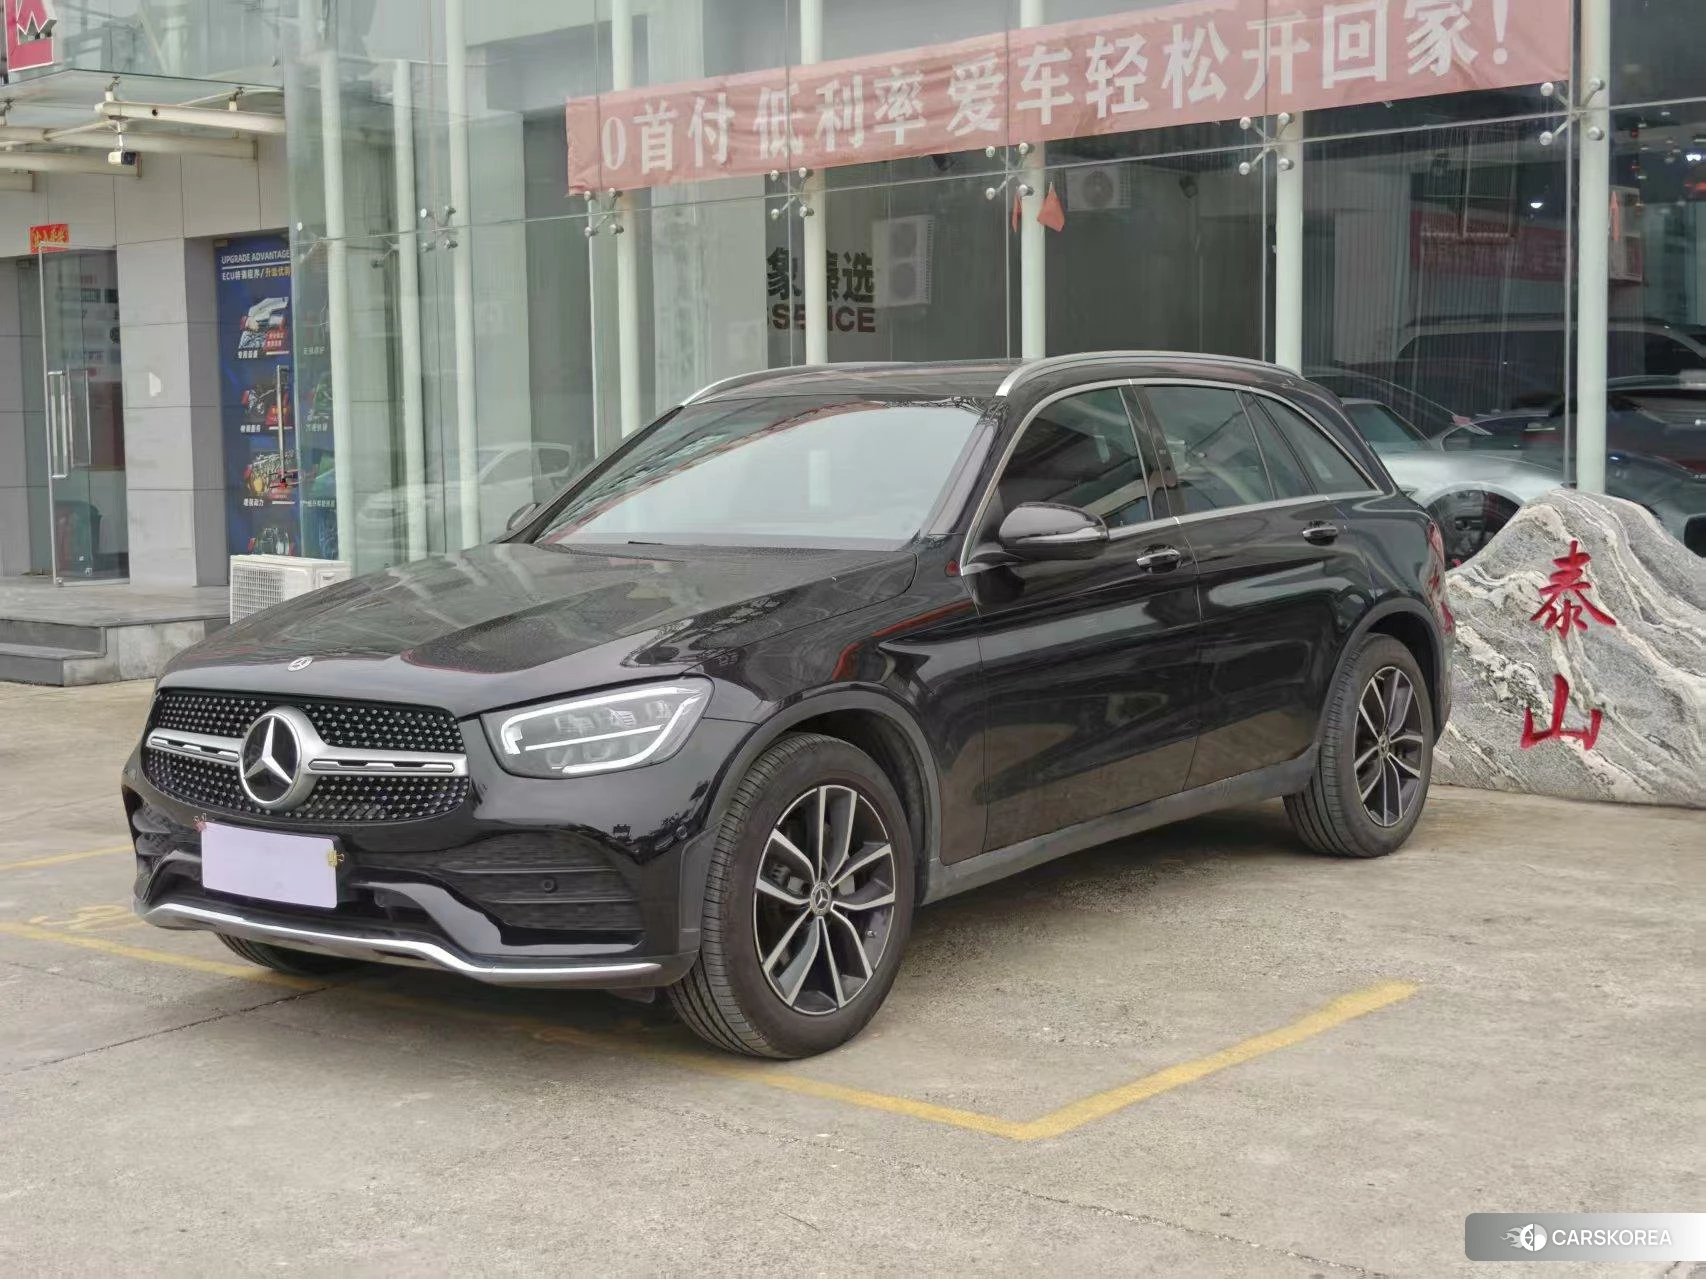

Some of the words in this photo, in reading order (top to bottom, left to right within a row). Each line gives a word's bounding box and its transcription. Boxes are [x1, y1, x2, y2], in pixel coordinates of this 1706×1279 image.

[221, 254, 250, 264] UPGRADE
[251, 250, 290, 261] ADVANTAGE
[1520, 539, 1617, 751] 泰山
